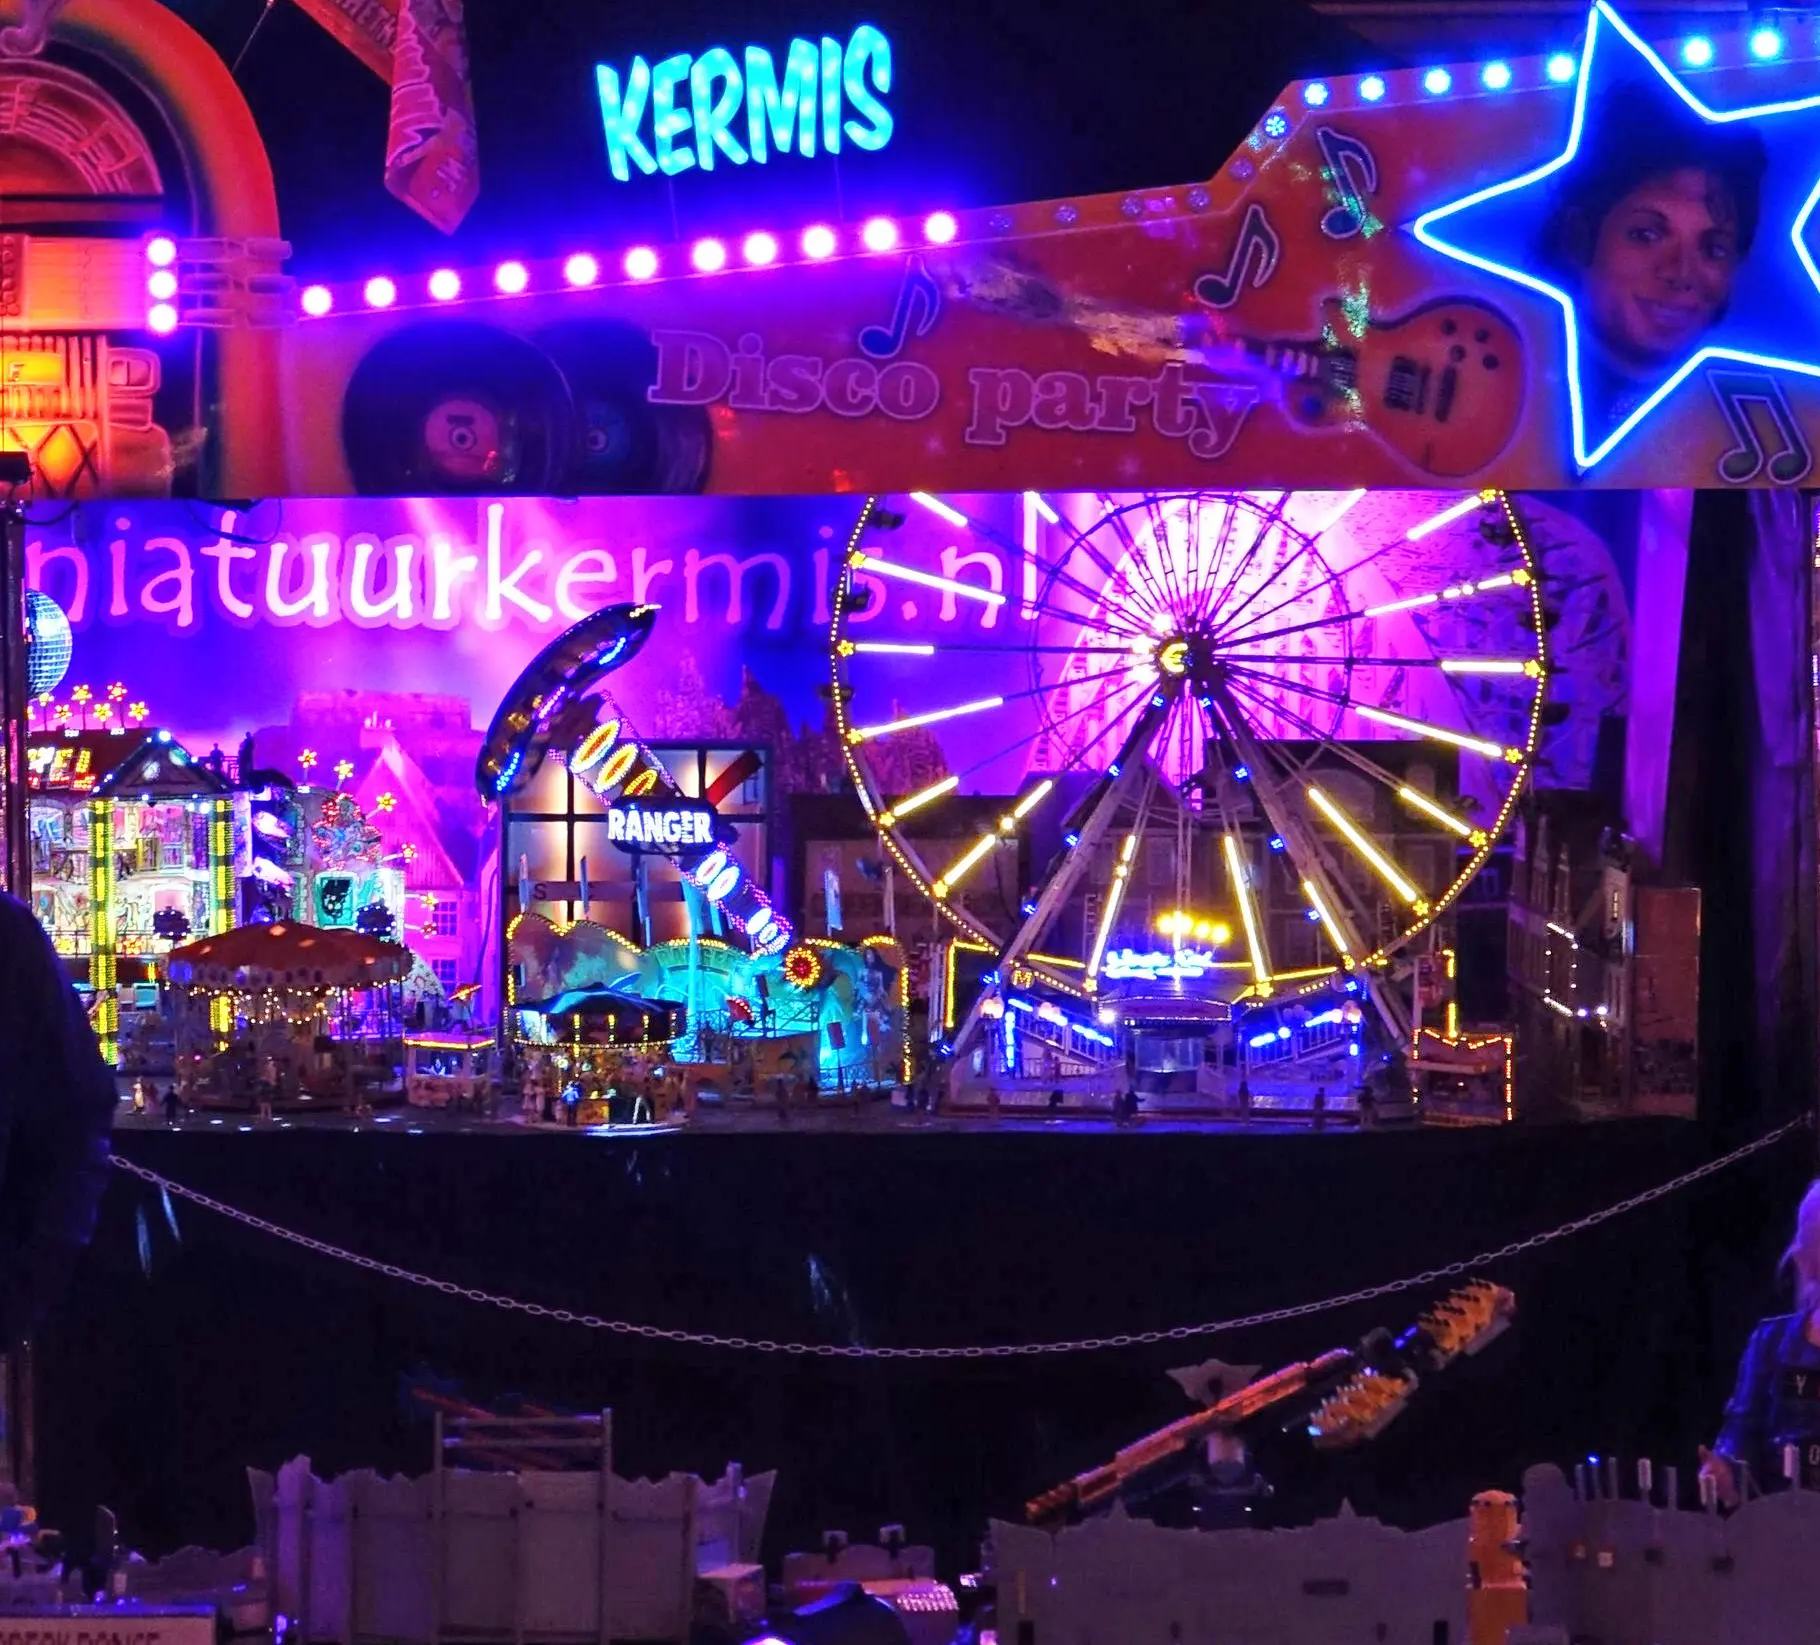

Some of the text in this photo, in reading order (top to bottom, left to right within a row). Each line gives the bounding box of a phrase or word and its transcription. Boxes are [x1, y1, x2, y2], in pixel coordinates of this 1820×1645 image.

[595, 24, 894, 182] KERMIS
[646, 328, 1261, 459] Disco party
[607, 807, 713, 844] RANGER
